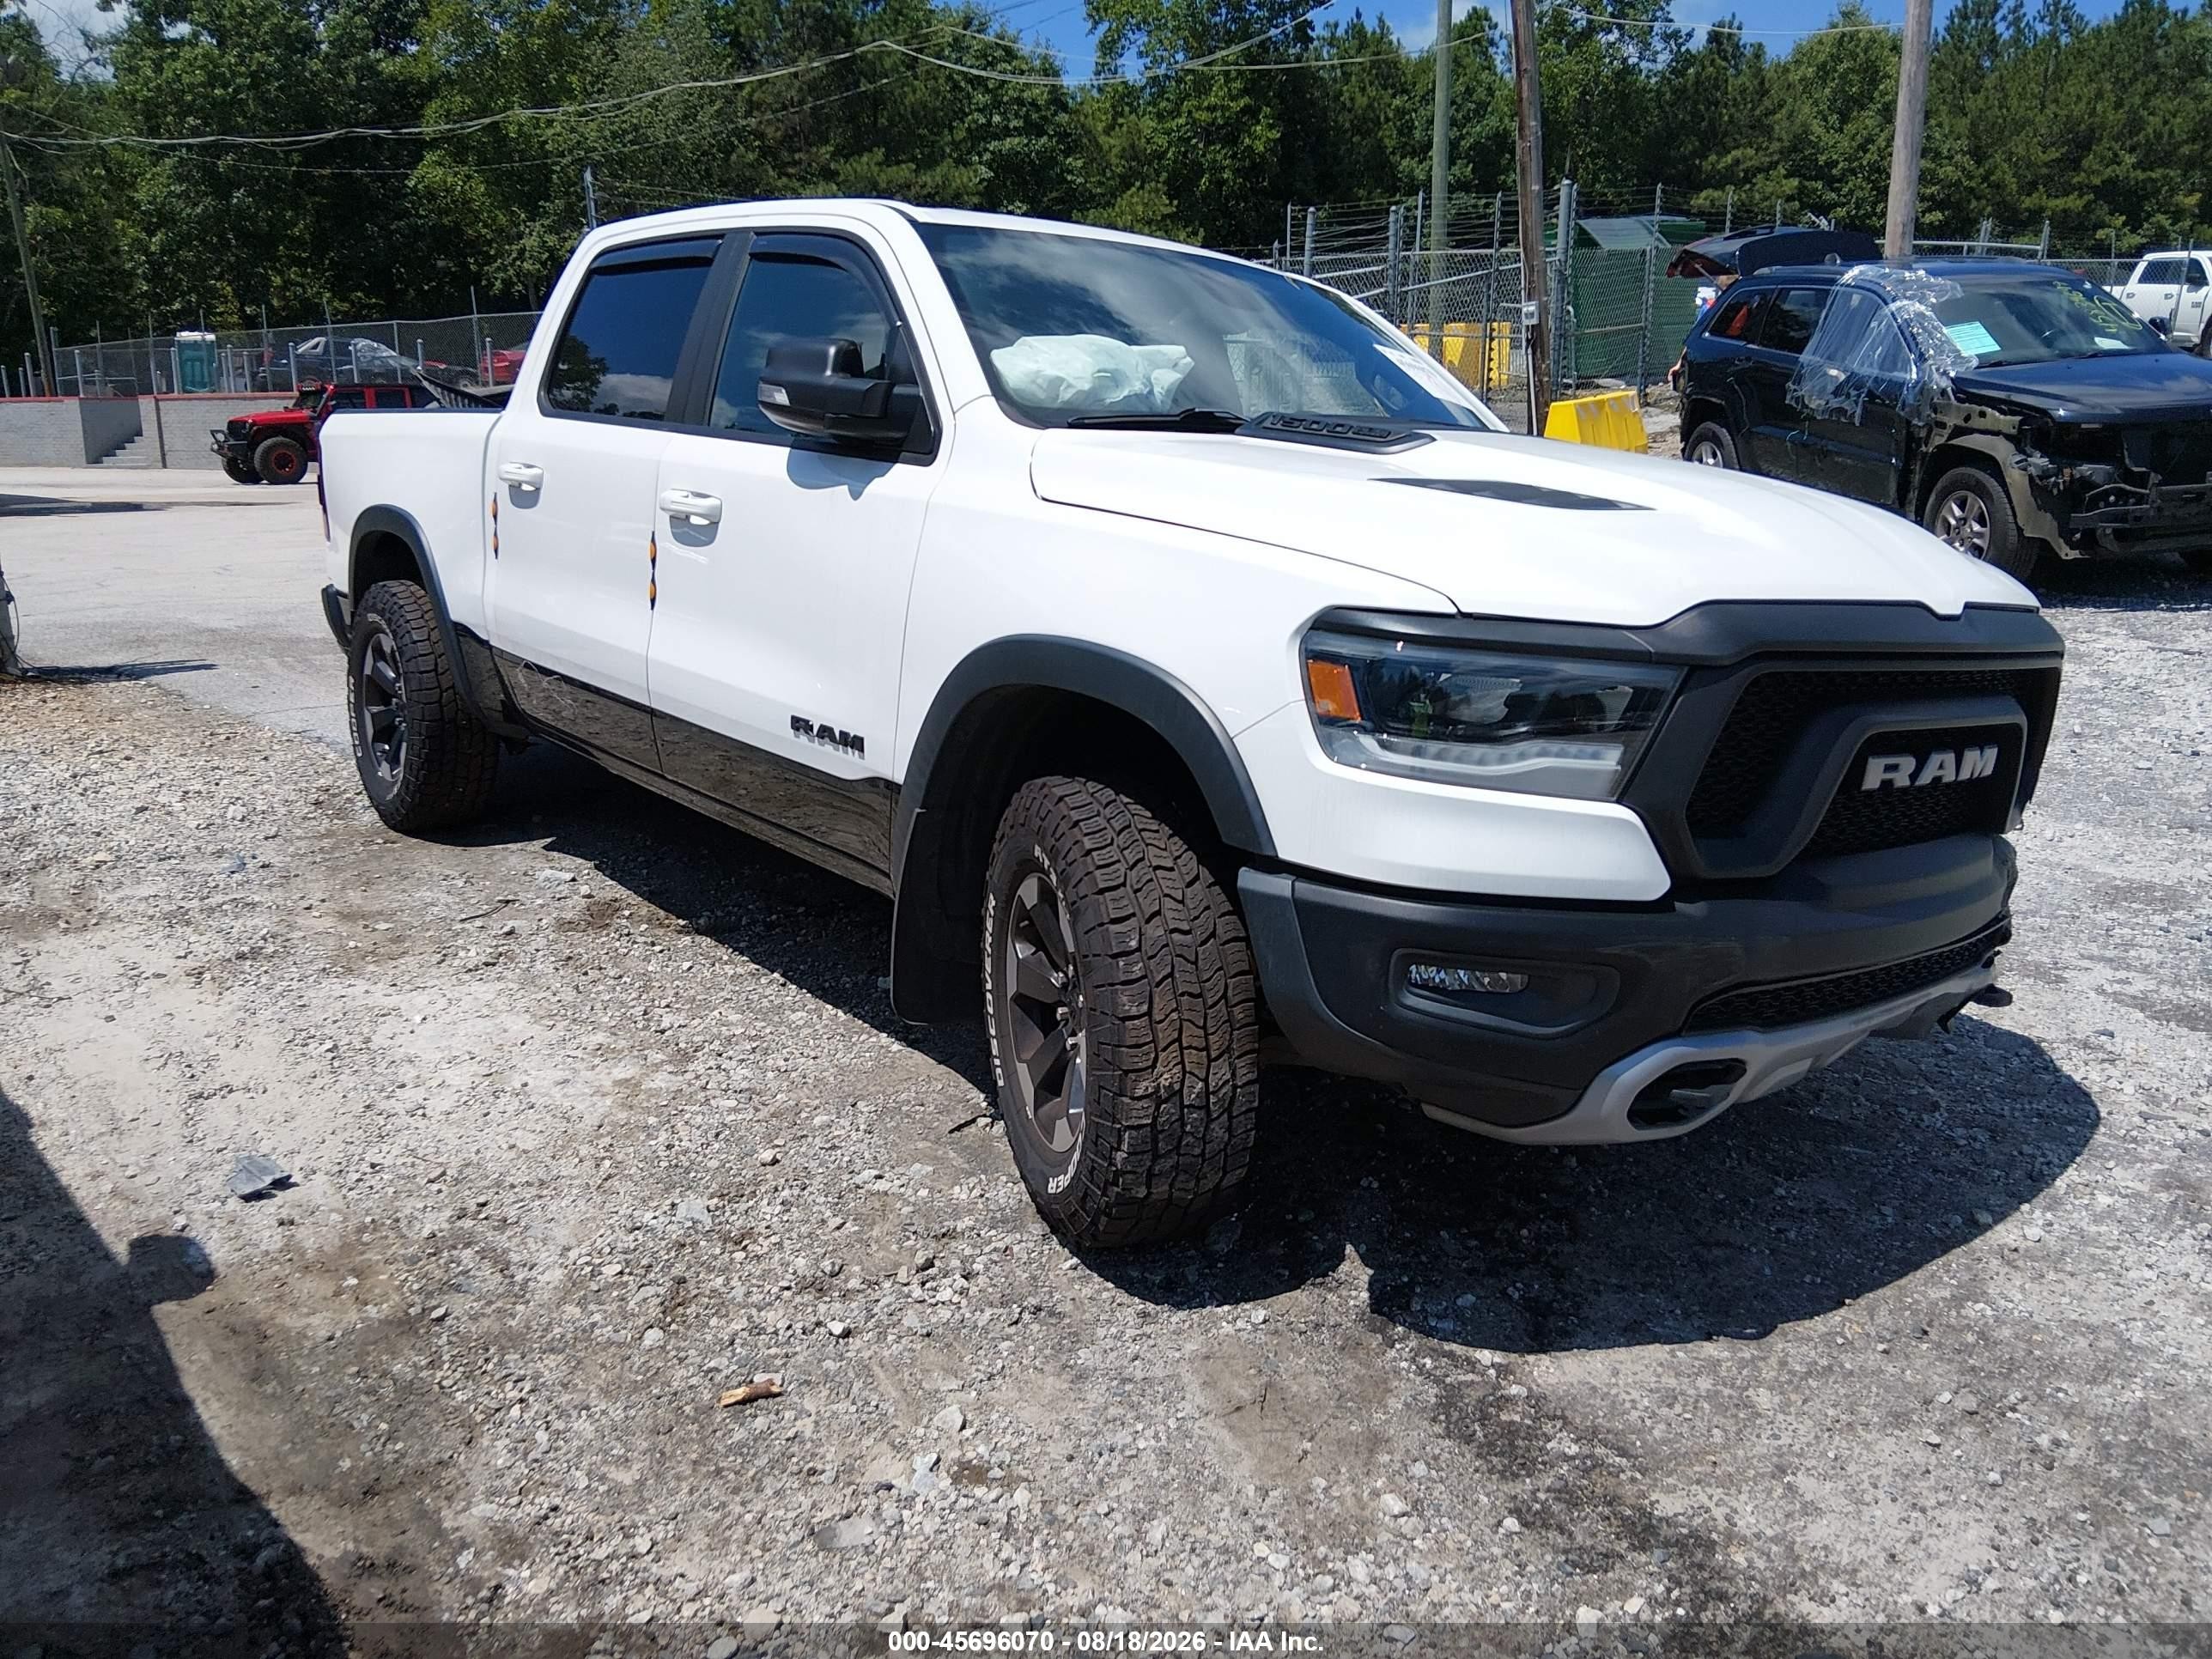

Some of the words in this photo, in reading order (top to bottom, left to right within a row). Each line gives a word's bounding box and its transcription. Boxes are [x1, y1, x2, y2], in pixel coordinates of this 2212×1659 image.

[791, 714, 866, 757] RAM
[1861, 744, 1999, 791] RAM
[984, 892, 1006, 1087] DISCOVERER
[1047, 1110, 1086, 1194] COOPER
